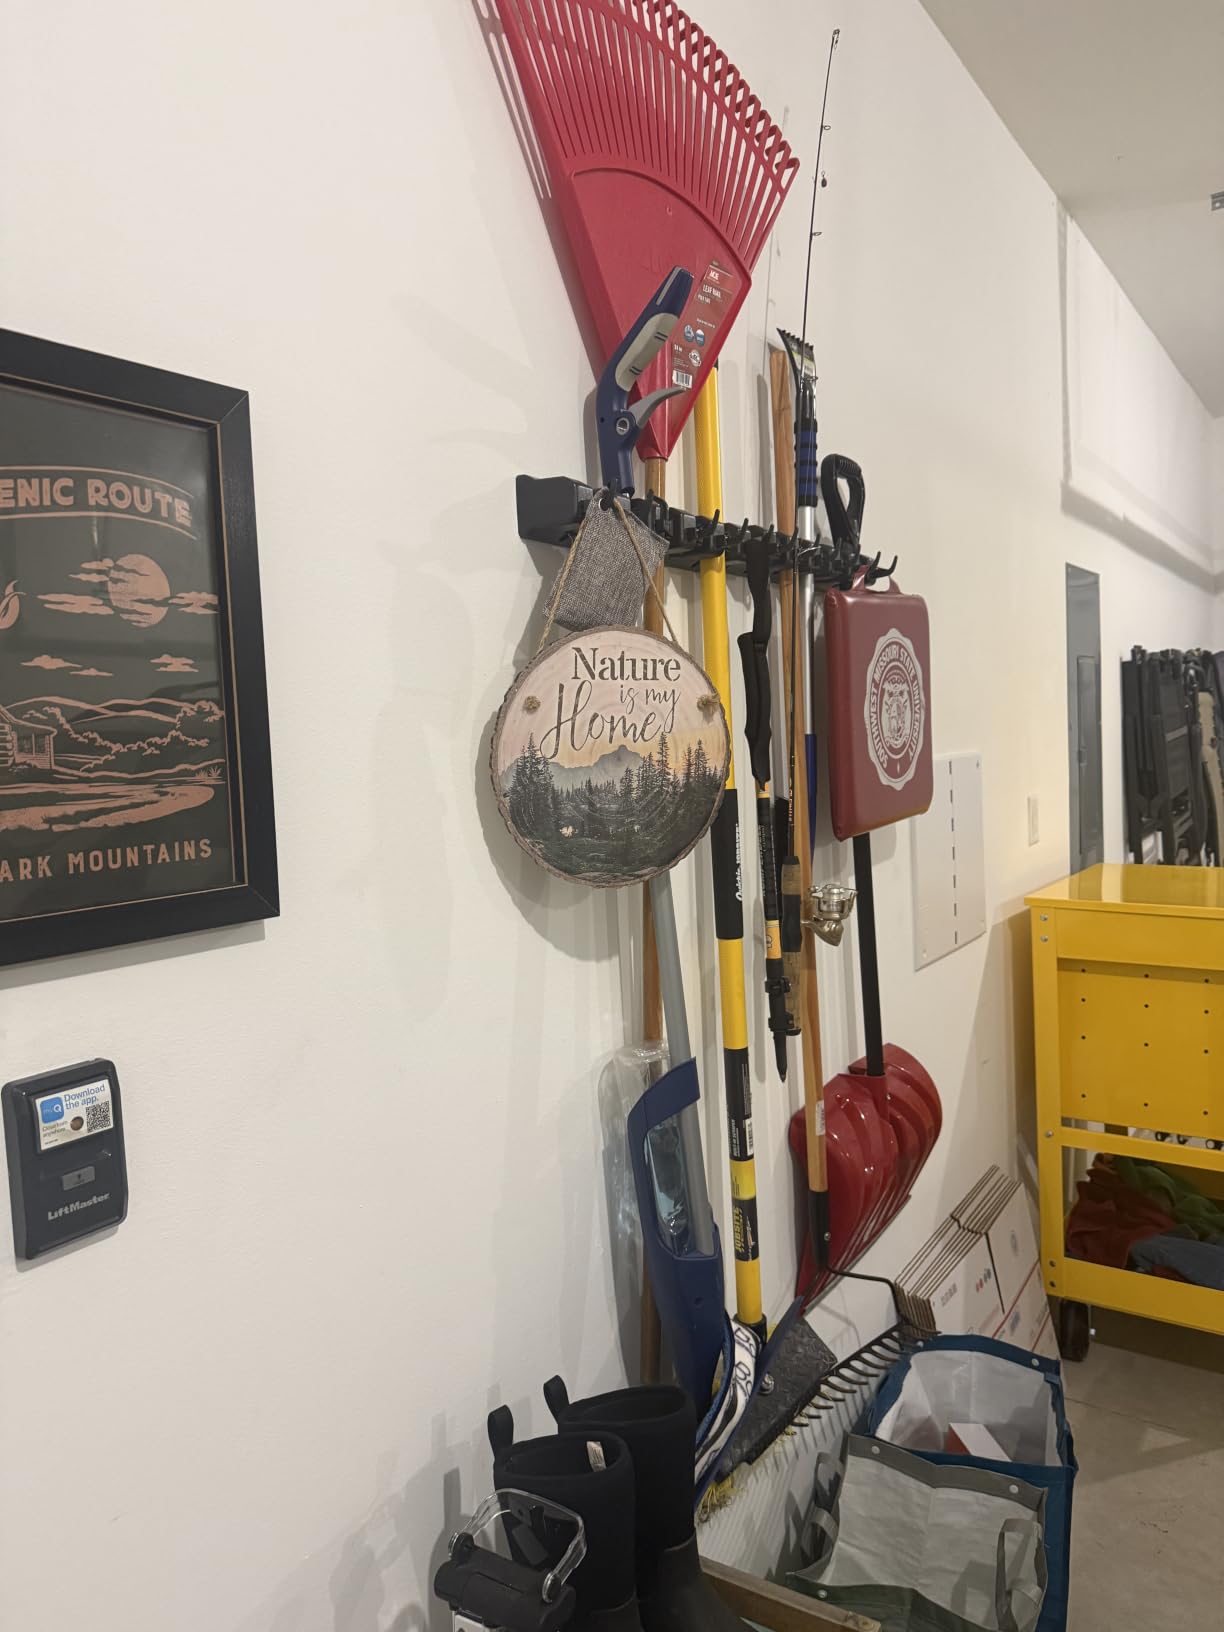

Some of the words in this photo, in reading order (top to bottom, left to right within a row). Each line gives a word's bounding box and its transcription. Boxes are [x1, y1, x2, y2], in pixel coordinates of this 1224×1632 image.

[87, 479, 193, 527] ROUTE
[571, 646, 681, 682] Nature
[874, 644, 899, 684] MISSOURI
[900, 647, 916, 681] STATE
[540, 679, 662, 760] Home
[619, 684, 639, 715] is
[646, 687, 681, 734] my
[870, 682, 888, 768] SOUTHWEST
[908, 680, 920, 761] UNIVERSITY
[0, 855, 53, 882] ARK
[68, 838, 213, 875] MOUNTAINS
[64, 1084, 106, 1103] Download
[65, 1101, 79, 1110] the
[81, 1095, 98, 1106] app.
[47, 1192, 110, 1221] LiftMaster
[733, 1206, 743, 1253] JOBSITE
